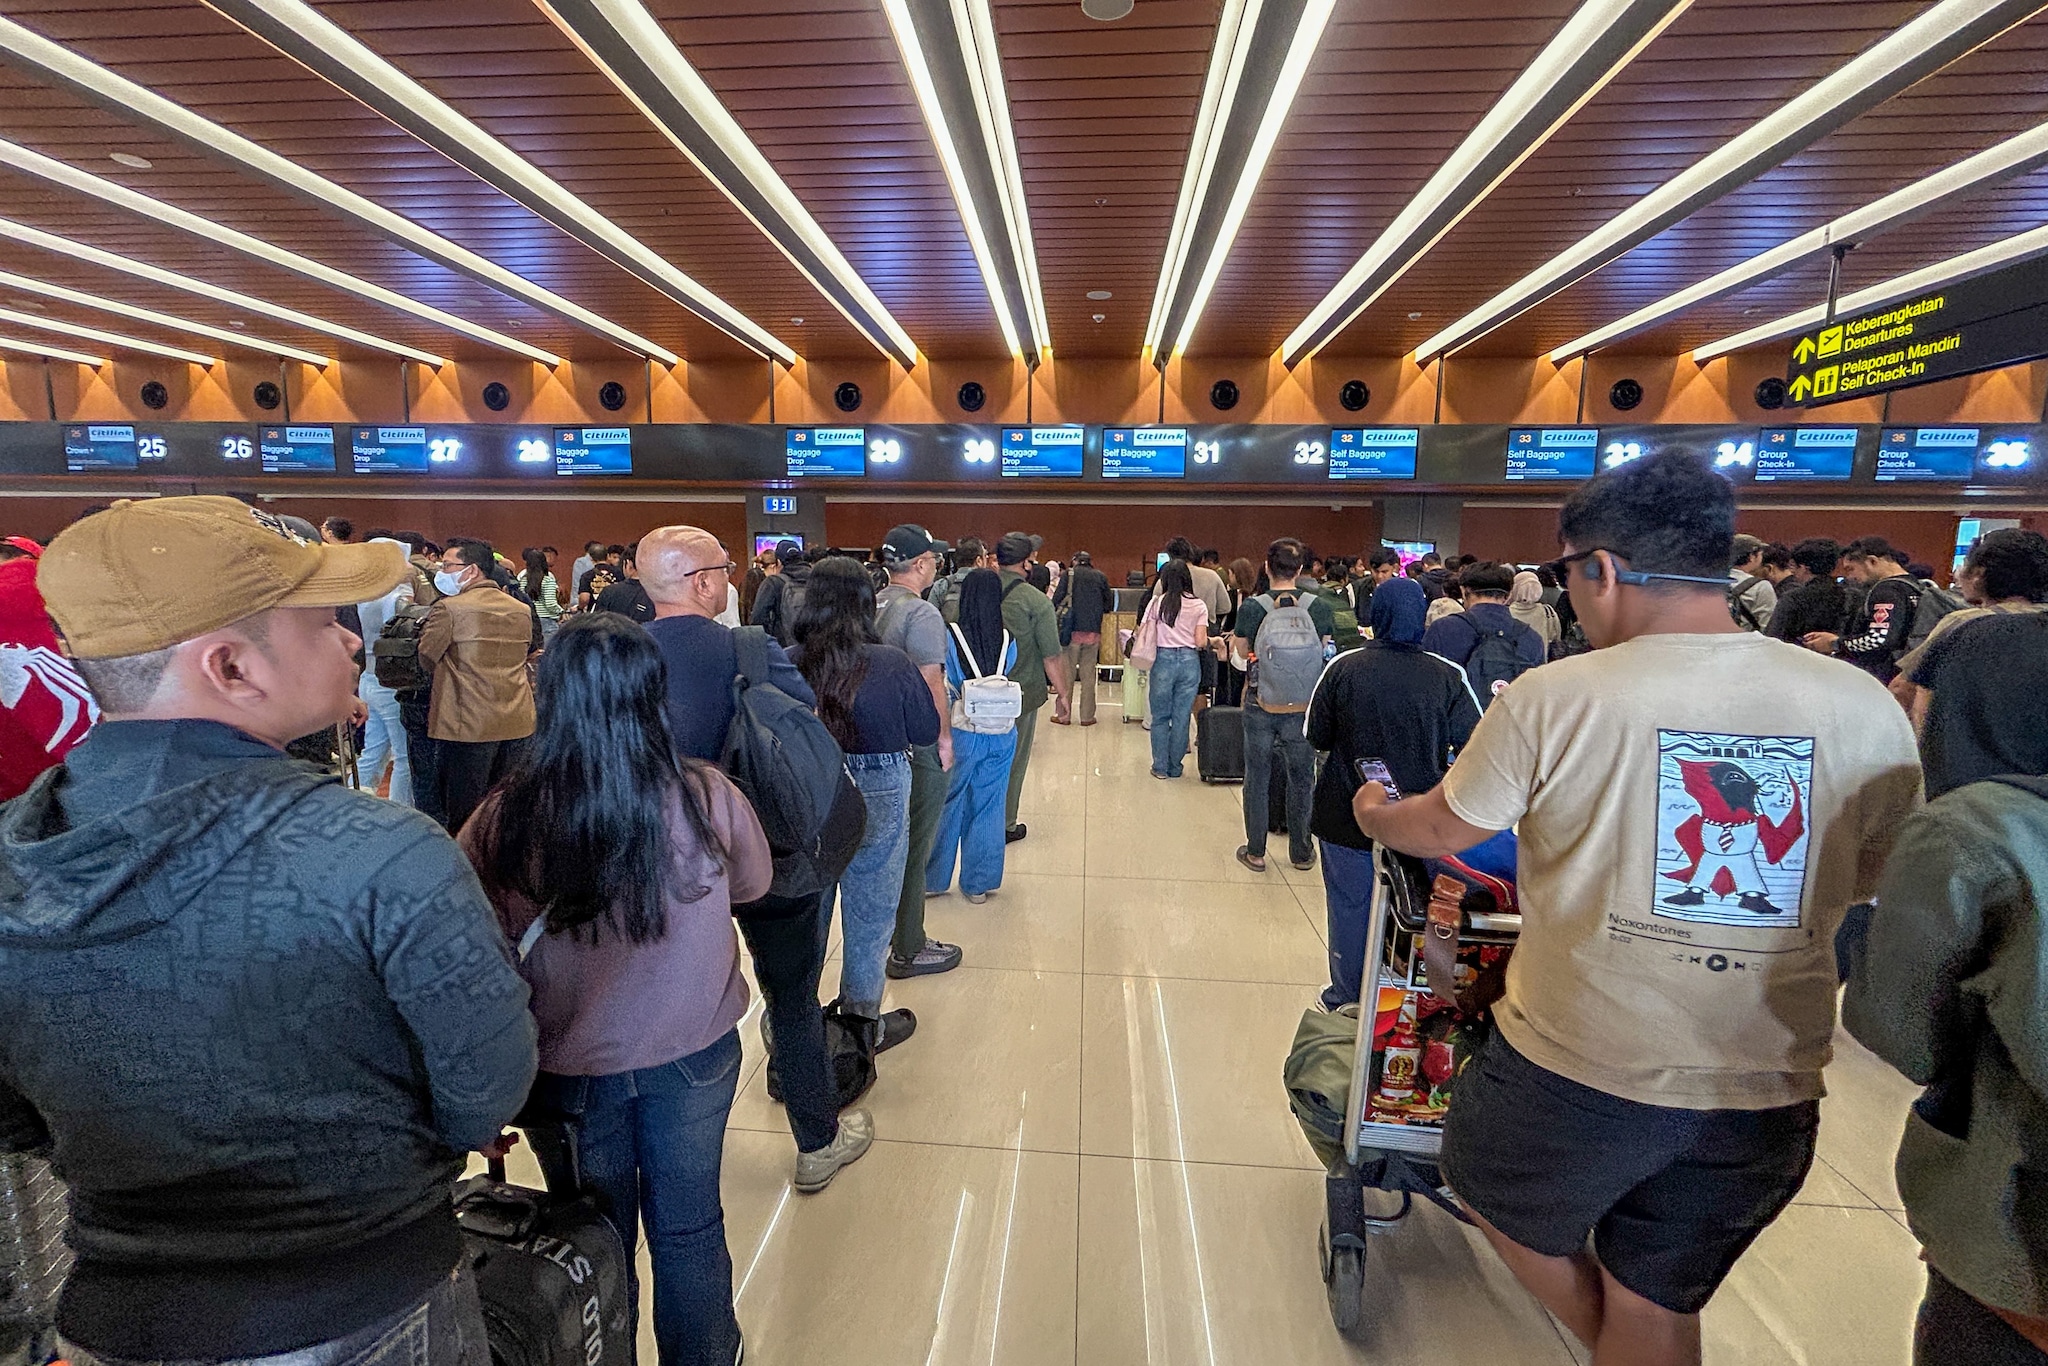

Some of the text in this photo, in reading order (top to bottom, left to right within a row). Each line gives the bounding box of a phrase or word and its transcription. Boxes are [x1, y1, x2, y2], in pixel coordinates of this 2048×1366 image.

[1845, 295, 1945, 336] Keberangkatan
[1844, 322, 1914, 352] Departures
[1842, 334, 1961, 376] Pelaporan Mandiri
[1840, 361, 1926, 392] Self Check-In
[1113, 433, 1124, 442] 31
[1340, 434, 1354, 443] 32
[138, 438, 168, 458] 25
[223, 439, 253, 459] 26
[429, 439, 463, 462] 27
[556, 448, 589, 457] Baggage
[787, 448, 822, 458] Baggage
[1002, 448, 1038, 458] Baggage
[1102, 448, 1157, 459] Self Baggage
[1193, 441, 1220, 464] 31
[1294, 441, 1325, 465] 32
[1330, 449, 1387, 460] Self Baggage
[1507, 449, 1566, 460] Self Baggage
[1714, 442, 1755, 467] 34
[1758, 449, 1789, 459] Group
[1878, 449, 1909, 460] Group
[556, 457, 573, 465] Drop
[787, 457, 805, 466] Drop
[1002, 457, 1021, 466] Drop
[1102, 457, 1122, 466] Drop
[1329, 459, 1349, 468] Drop
[1506, 459, 1527, 468] Drop
[1757, 459, 1796, 468] Check-In
